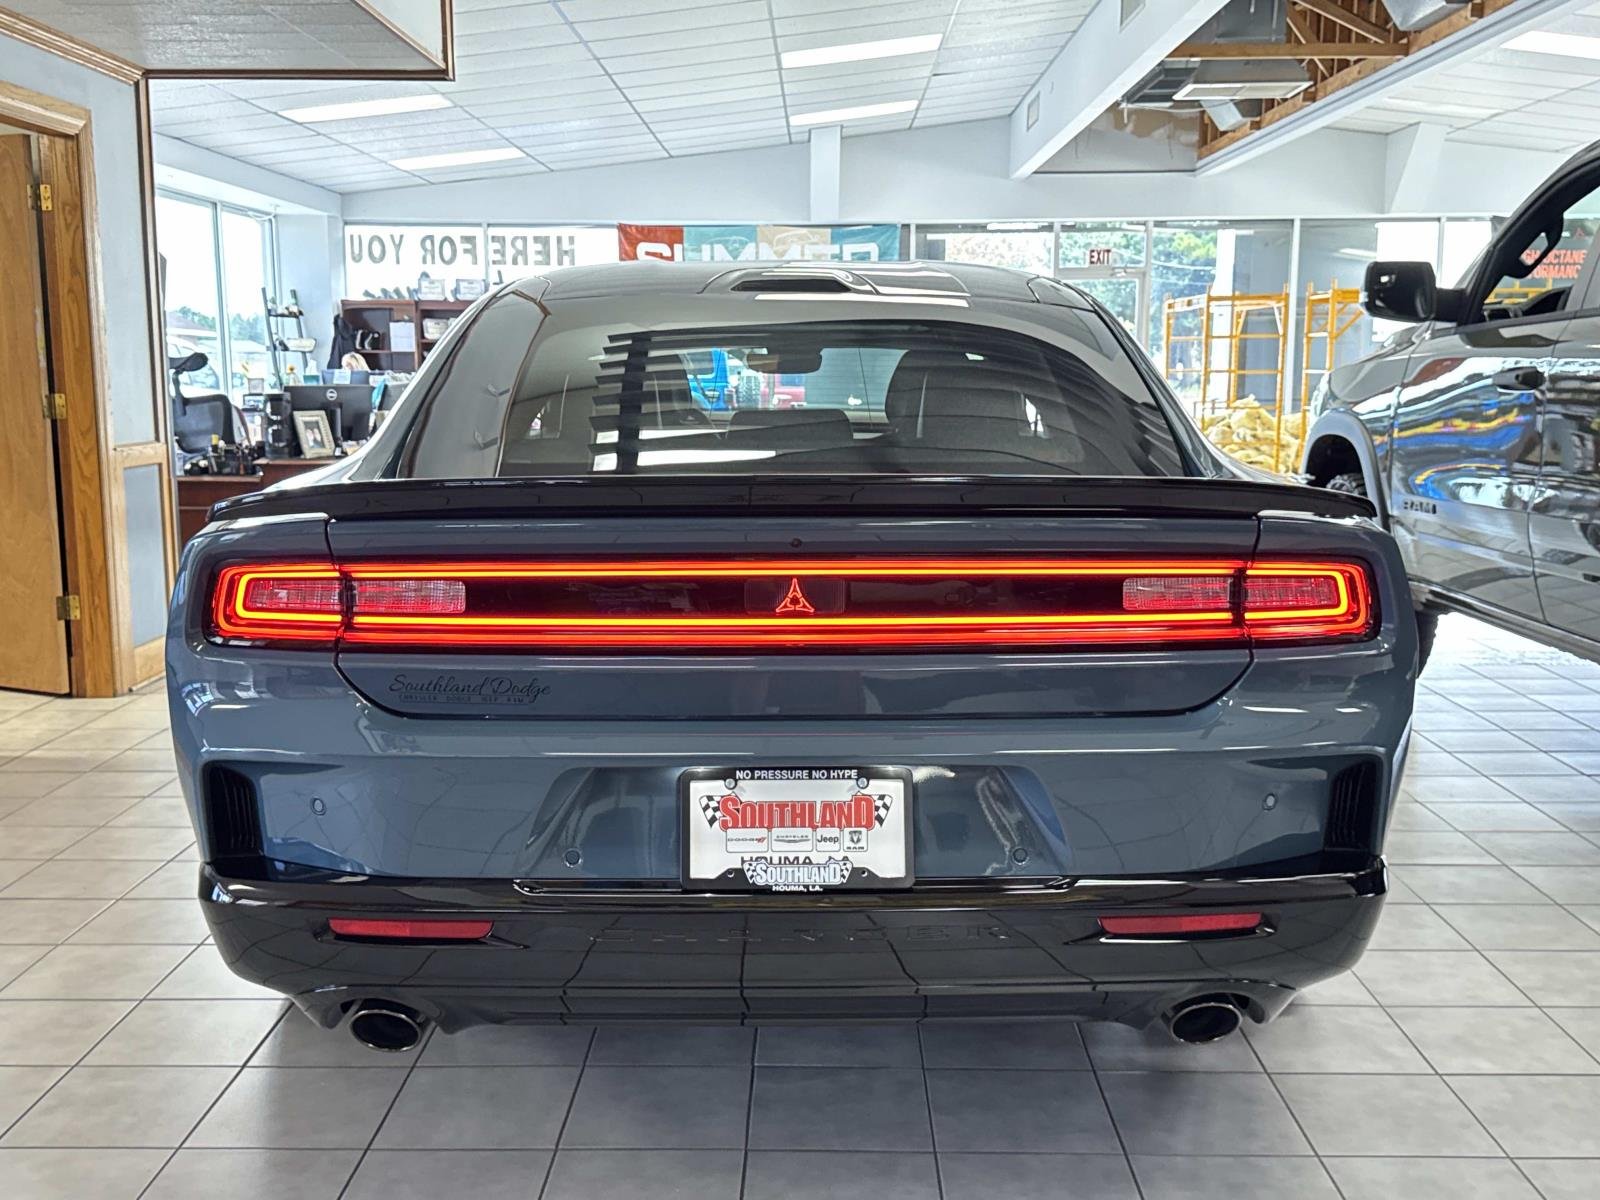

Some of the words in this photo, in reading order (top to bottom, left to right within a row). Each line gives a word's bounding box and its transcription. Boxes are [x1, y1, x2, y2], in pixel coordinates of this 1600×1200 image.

[1089, 249, 1112, 265] EXIT
[388, 673, 488, 696] Southland
[489, 676, 552, 704] Dodge
[736, 770, 752, 780] NO
[755, 770, 809, 780] PRESSURE
[811, 770, 828, 780] NO
[830, 769, 858, 779] HYPE
[719, 795, 875, 831] SOUTHLAND
[817, 834, 839, 844] Jeep
[755, 862, 841, 884] SOUTHLAND
